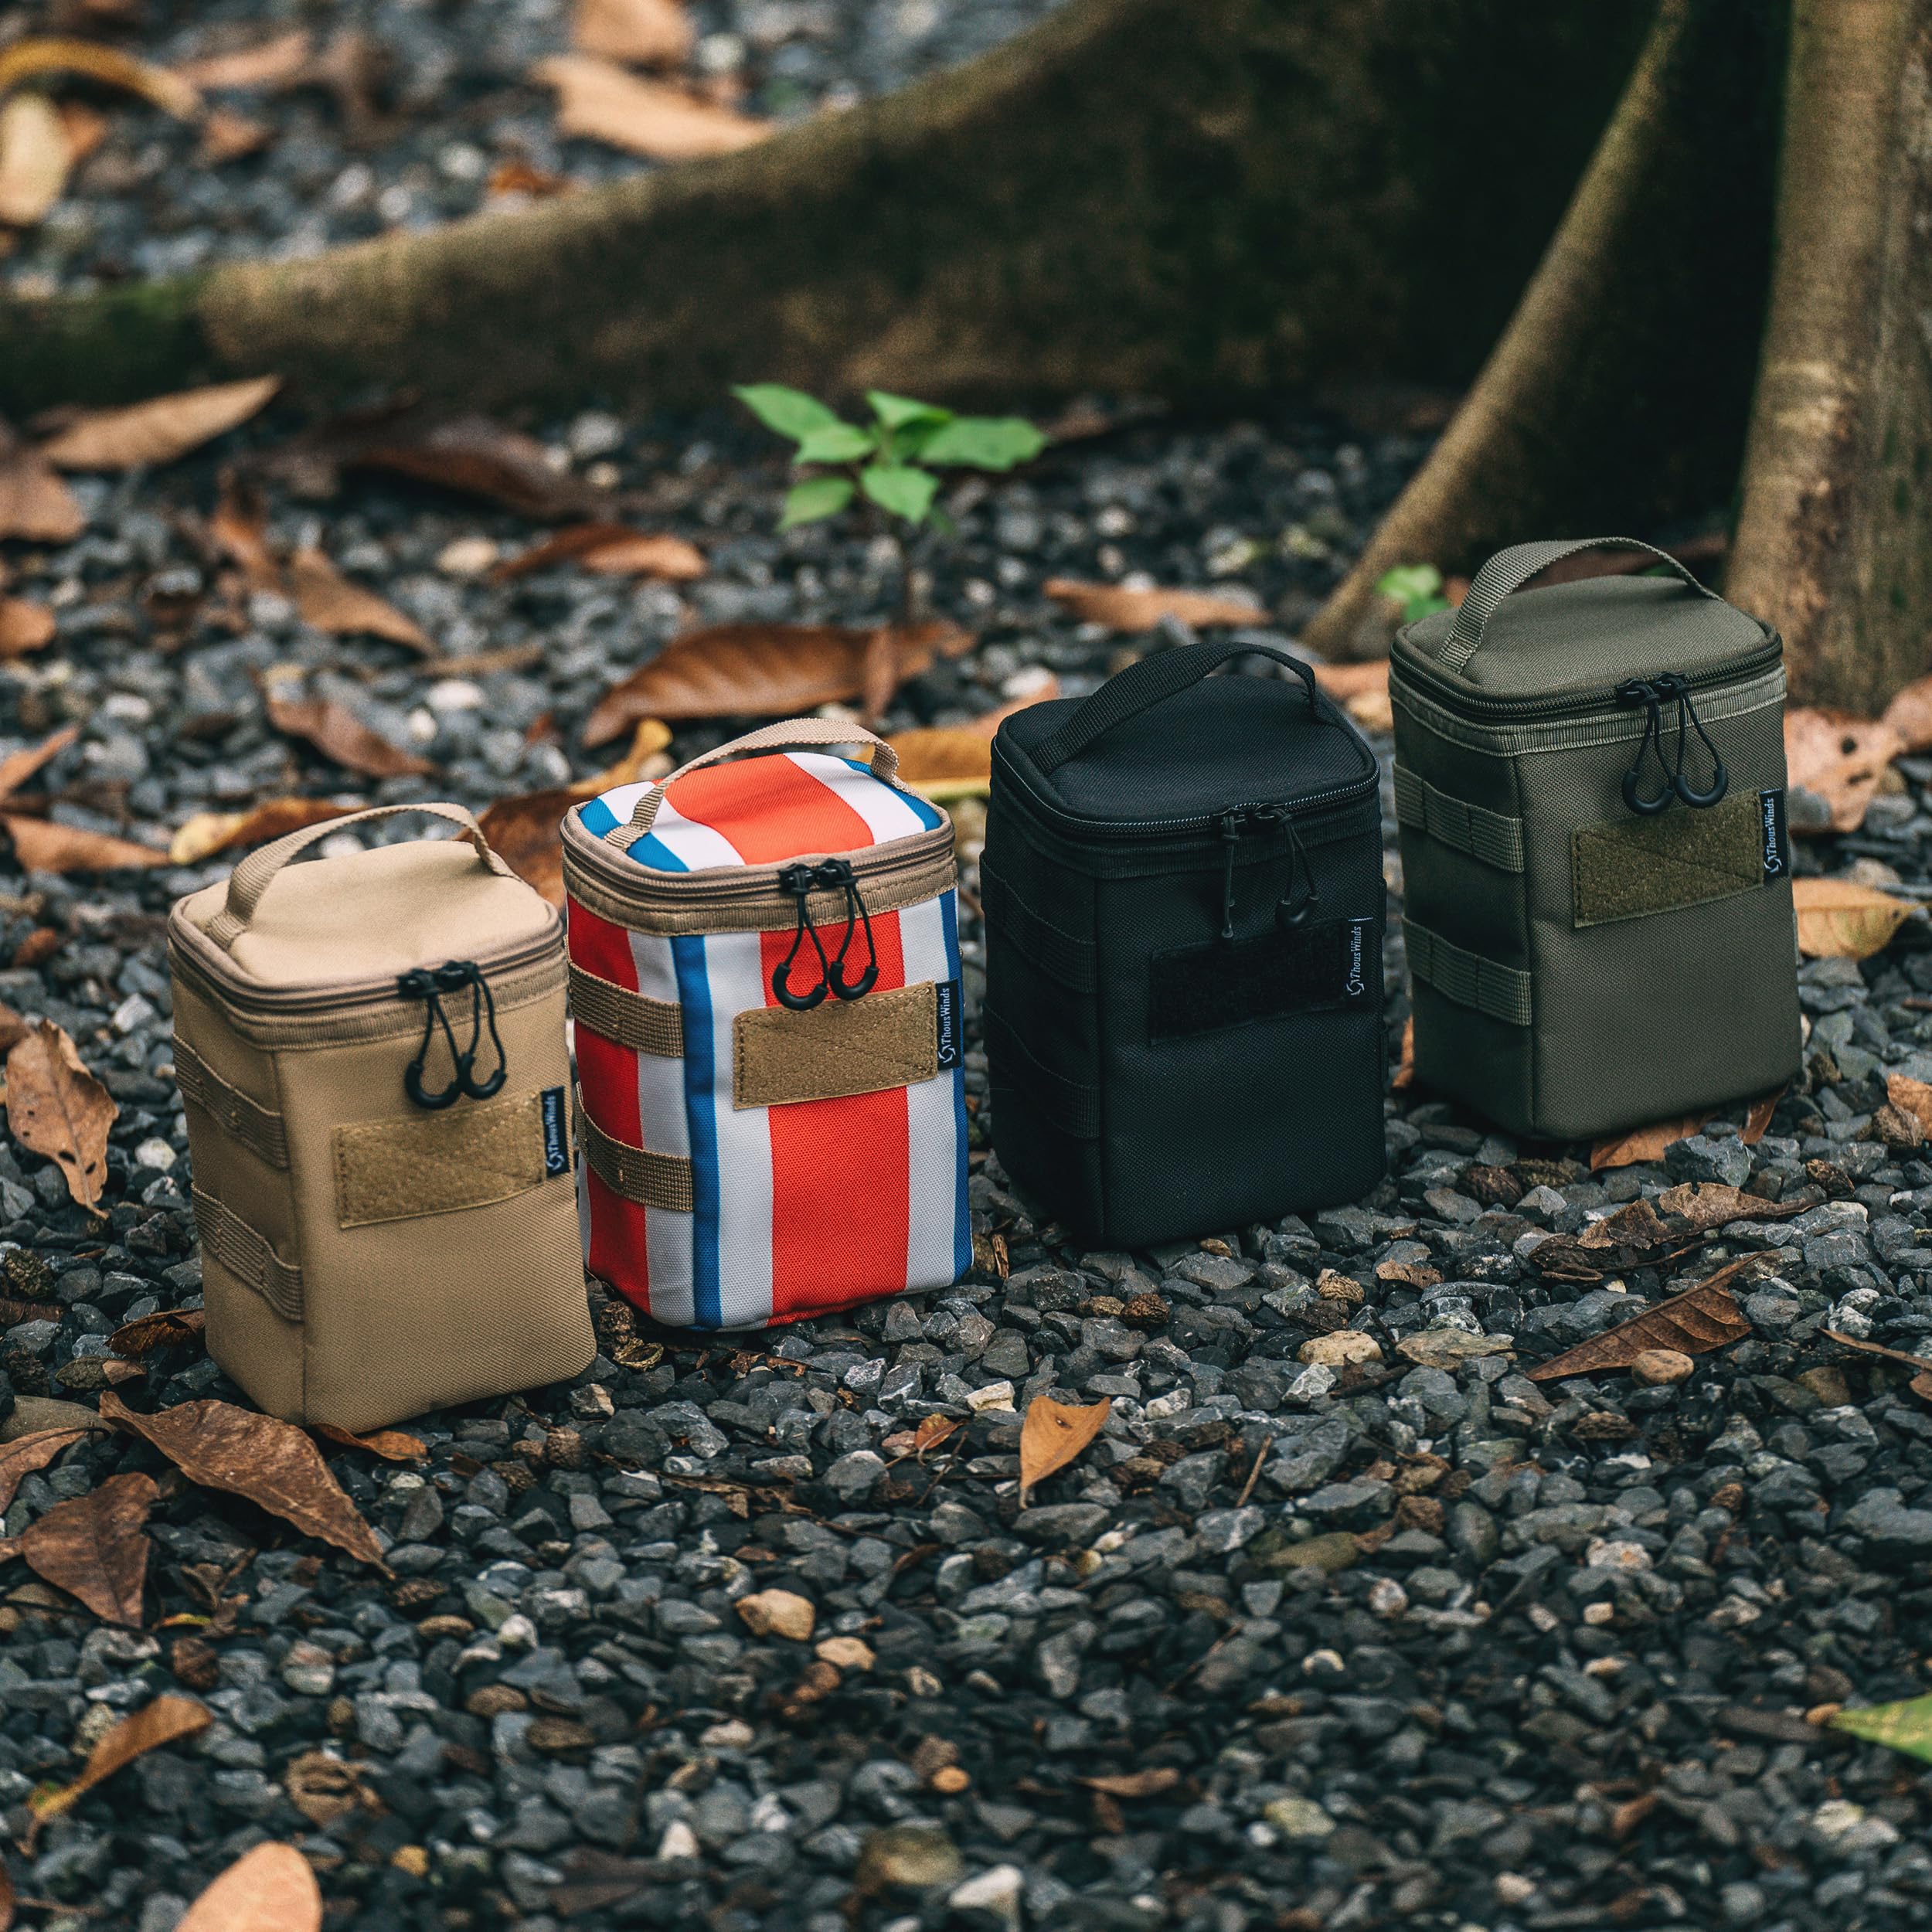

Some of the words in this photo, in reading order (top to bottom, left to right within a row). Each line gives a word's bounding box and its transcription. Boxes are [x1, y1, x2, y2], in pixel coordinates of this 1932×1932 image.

[1764, 798, 1777, 855] ThousWinds
[1350, 926, 1362, 978] ThousWinds
[940, 988, 951, 1045] ThousWinds
